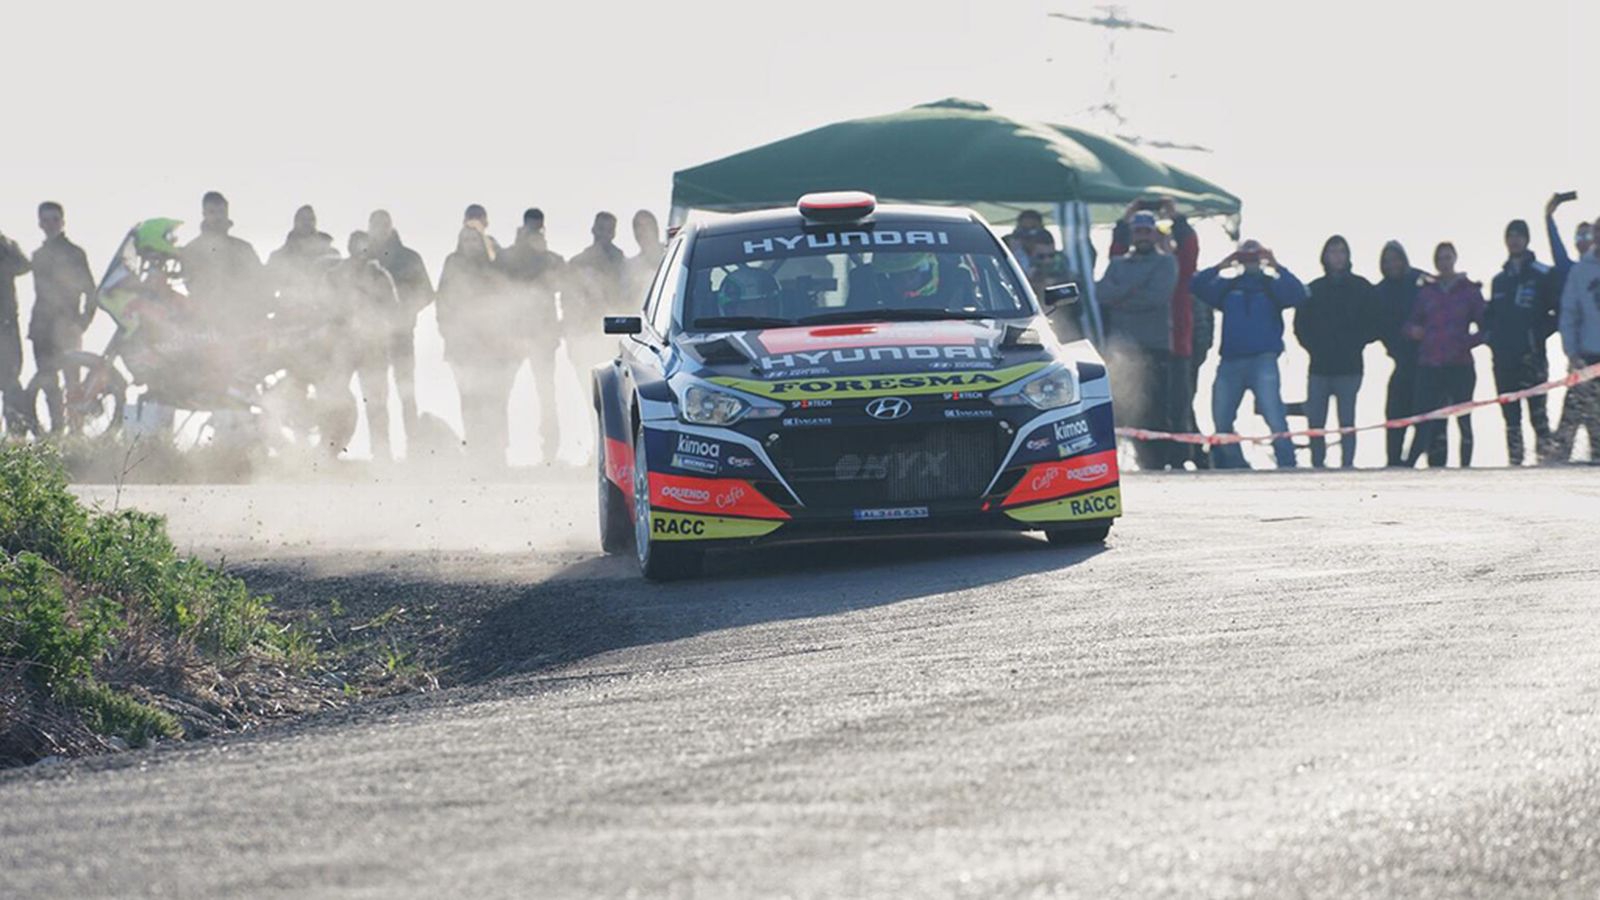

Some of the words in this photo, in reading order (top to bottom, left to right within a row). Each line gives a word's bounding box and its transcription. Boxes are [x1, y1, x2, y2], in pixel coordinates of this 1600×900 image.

[744, 231, 949, 253] HYUNDAI
[761, 346, 992, 370] HYUNDAI
[770, 374, 1001, 394] FORESMA
[1053, 420, 1089, 441] kimoa
[677, 434, 720, 457] kimoa
[1067, 463, 1108, 481] OQUENDO
[662, 486, 710, 503] OQUENDO
[1070, 495, 1117, 515] RACC
[653, 518, 705, 535] RACC
